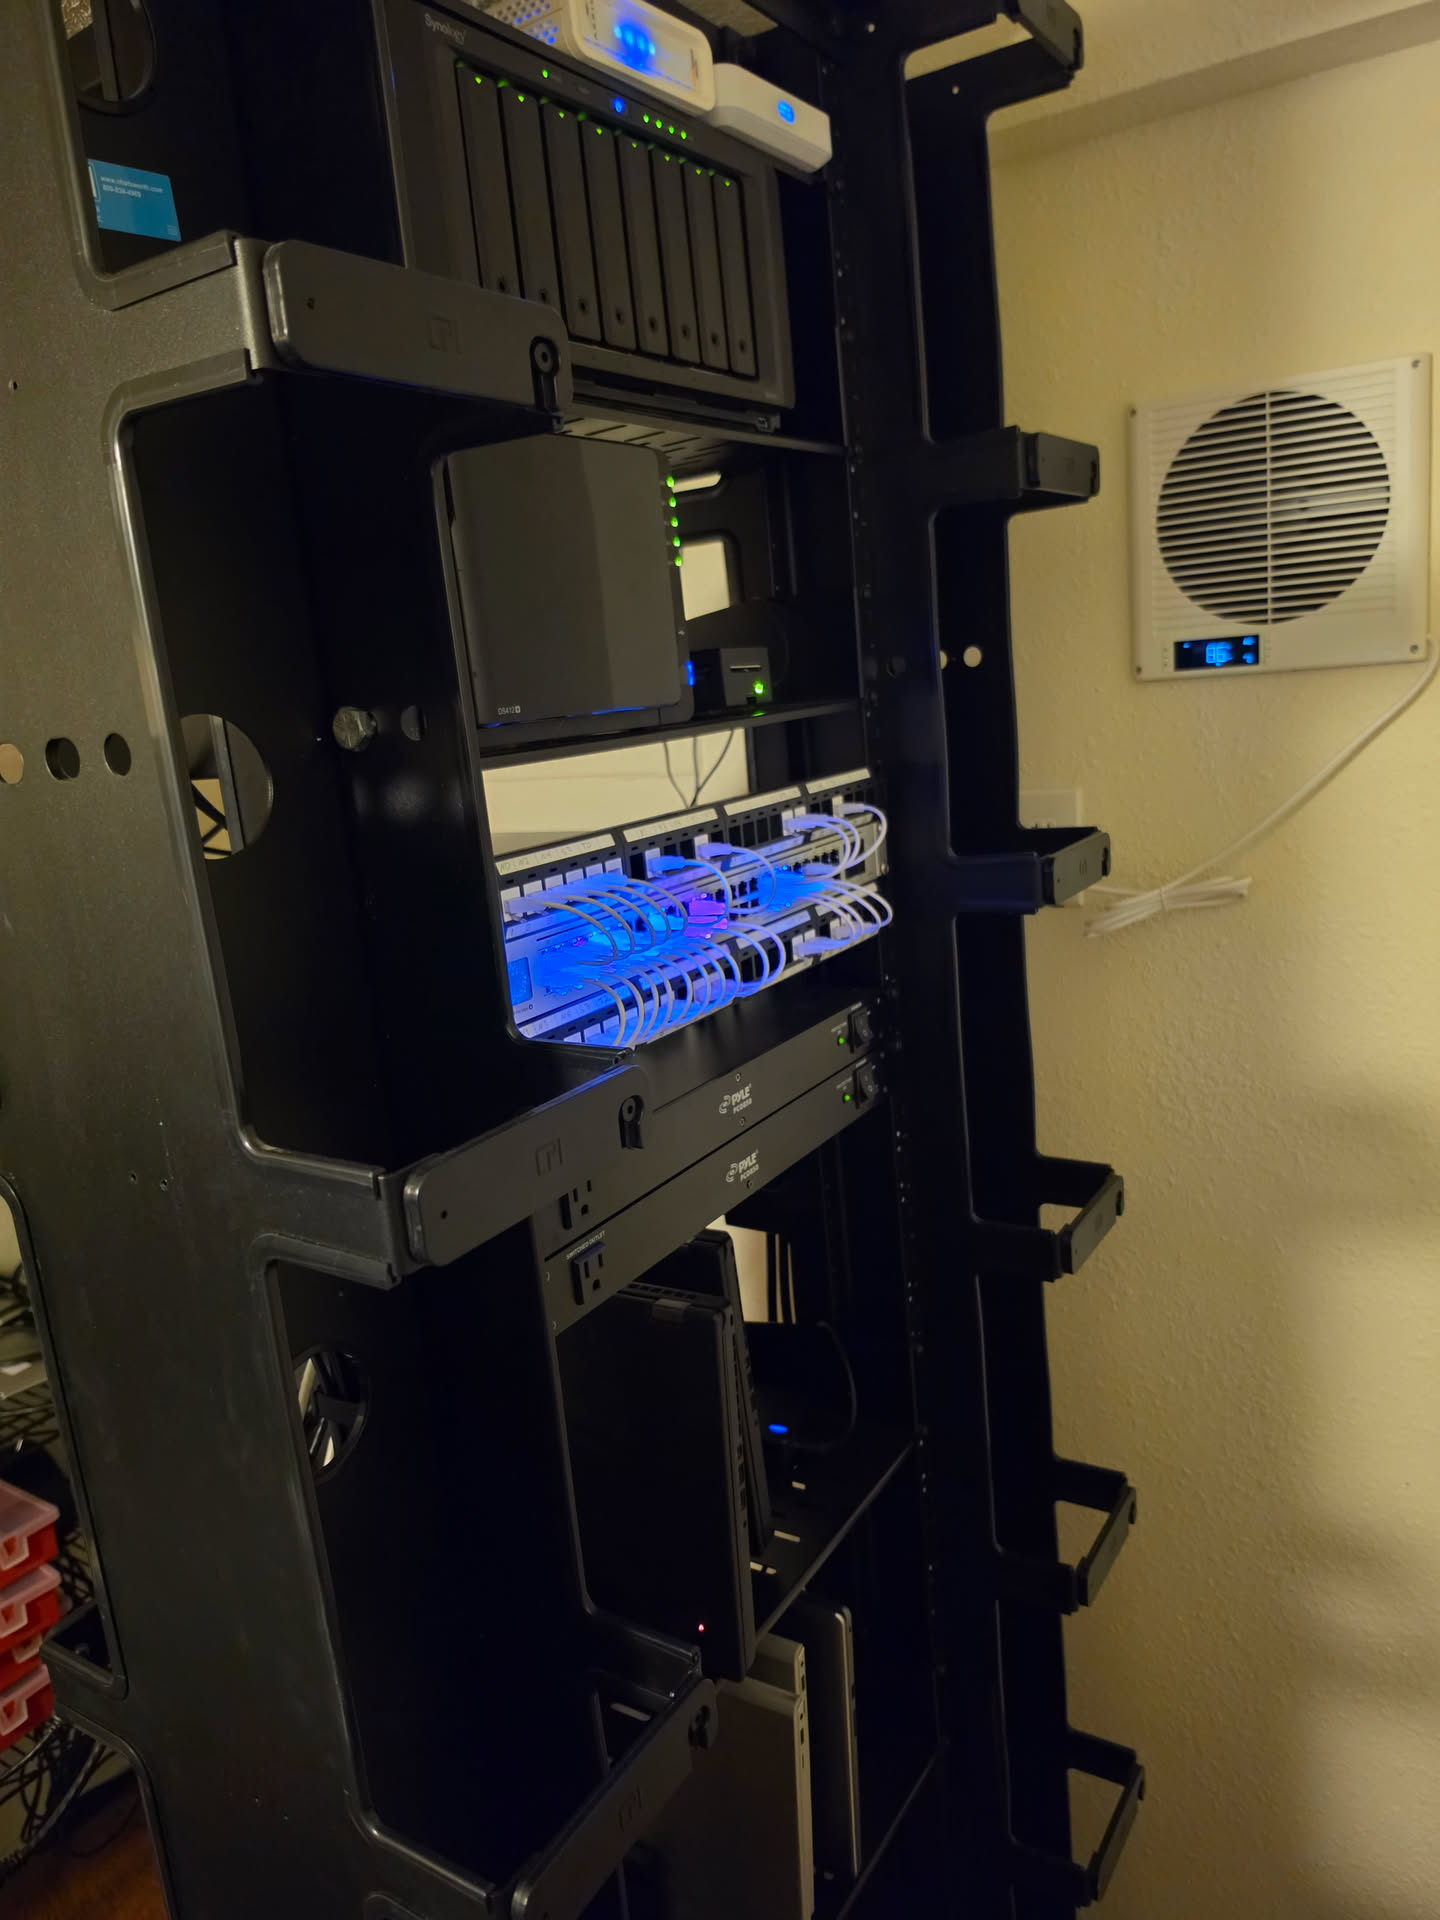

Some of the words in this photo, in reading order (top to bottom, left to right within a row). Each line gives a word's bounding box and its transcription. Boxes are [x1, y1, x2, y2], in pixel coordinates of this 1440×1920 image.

[424, 12, 467, 46] Synology
[732, 1086, 751, 1107] PYLE
[739, 1152, 757, 1174] PYLE
